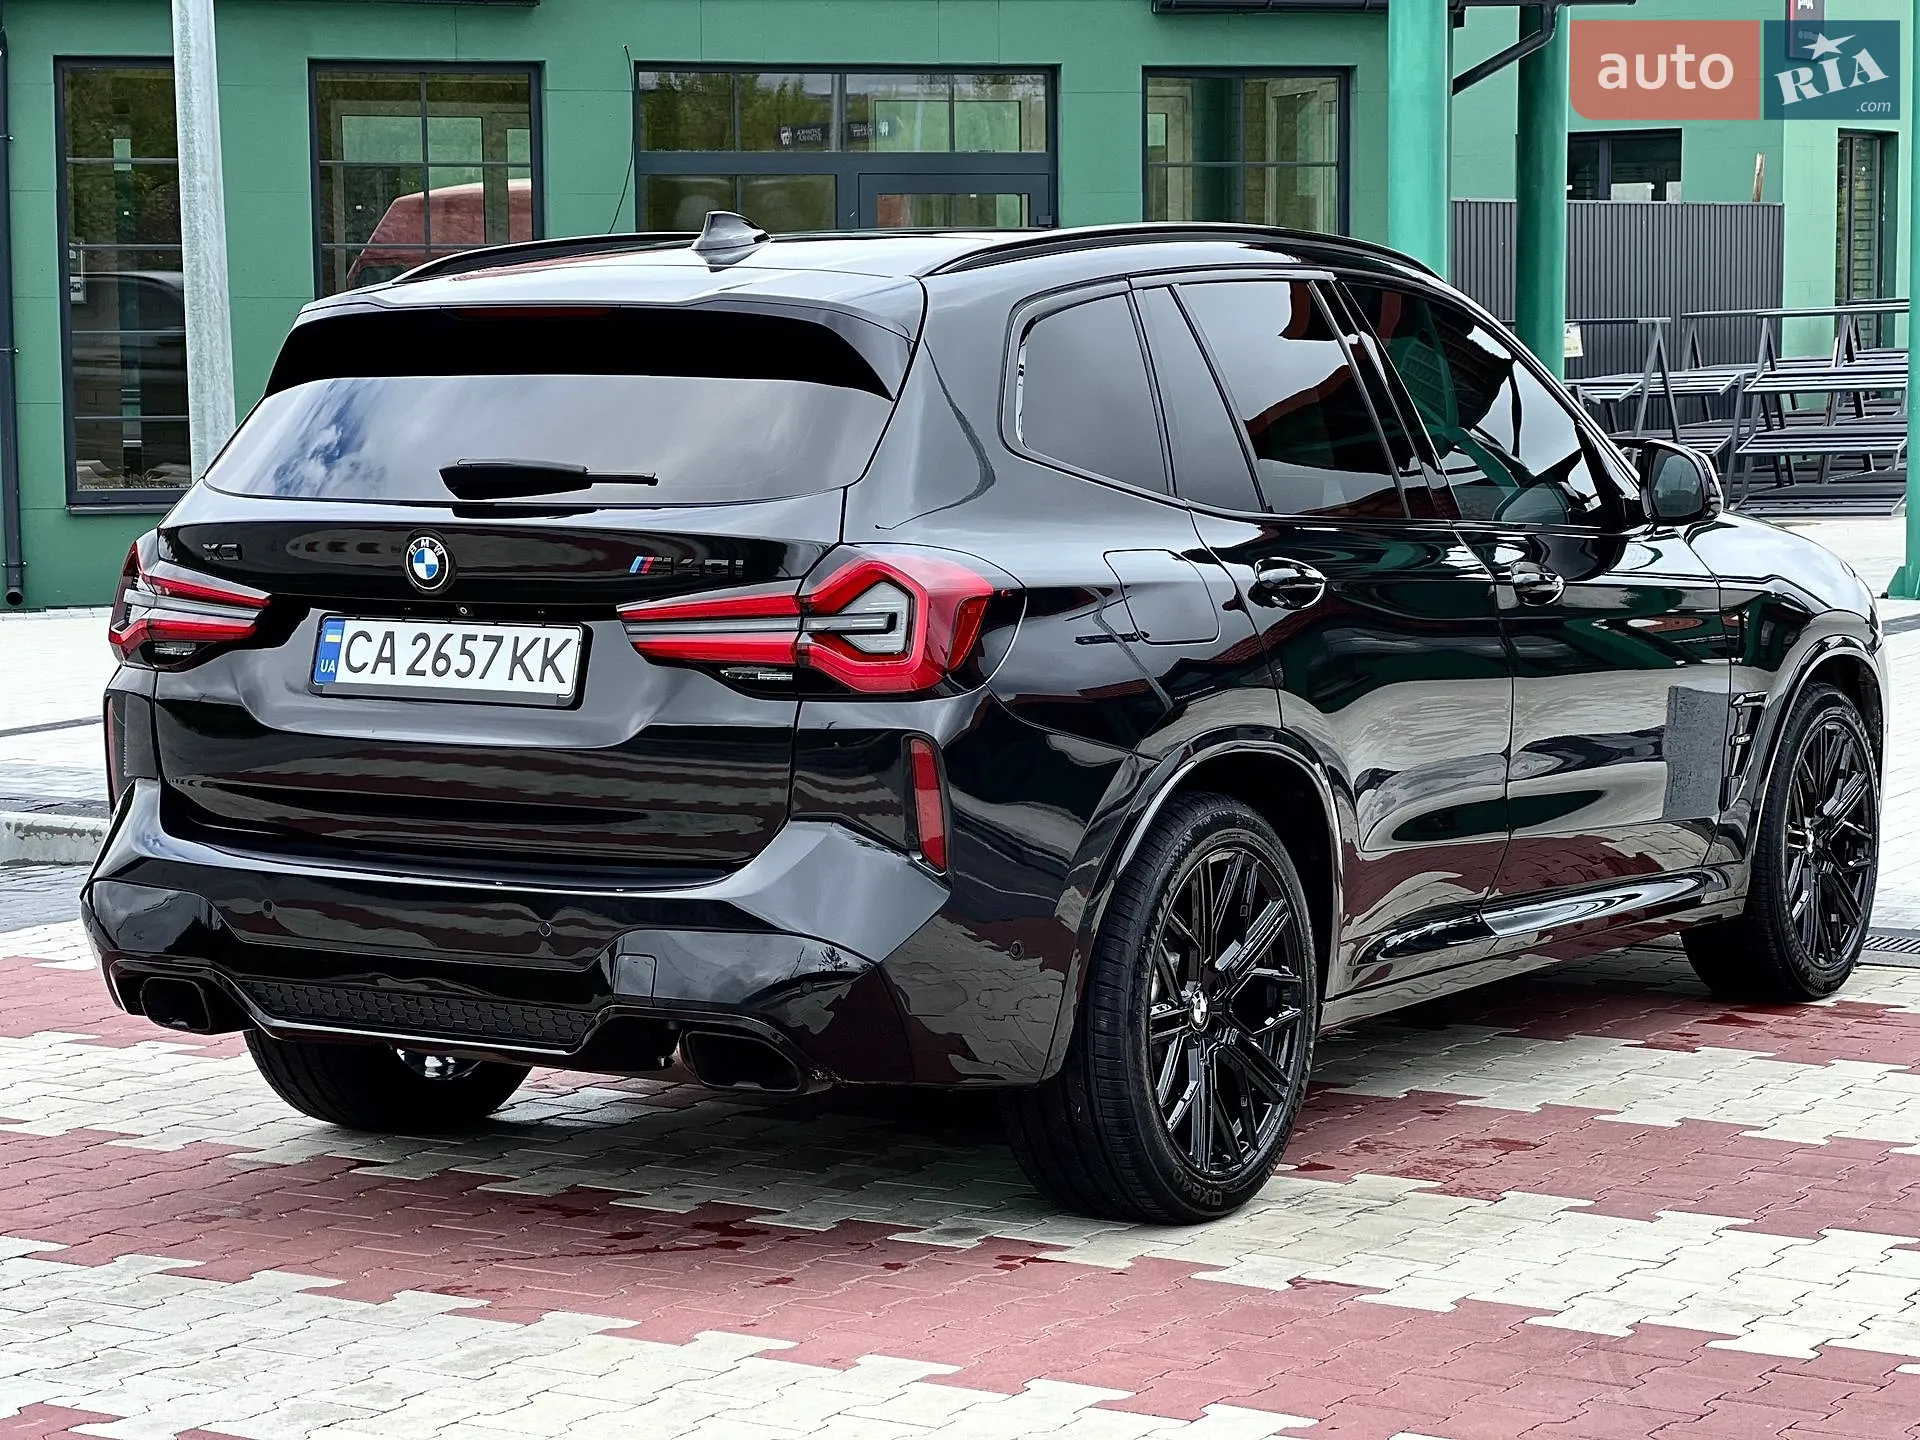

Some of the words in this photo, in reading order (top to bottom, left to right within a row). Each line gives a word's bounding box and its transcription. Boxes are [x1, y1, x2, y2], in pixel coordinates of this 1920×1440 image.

[320, 659, 336, 673] UA
[345, 629, 397, 676] CA
[405, 631, 505, 680] 2657
[508, 635, 573, 684] KK
